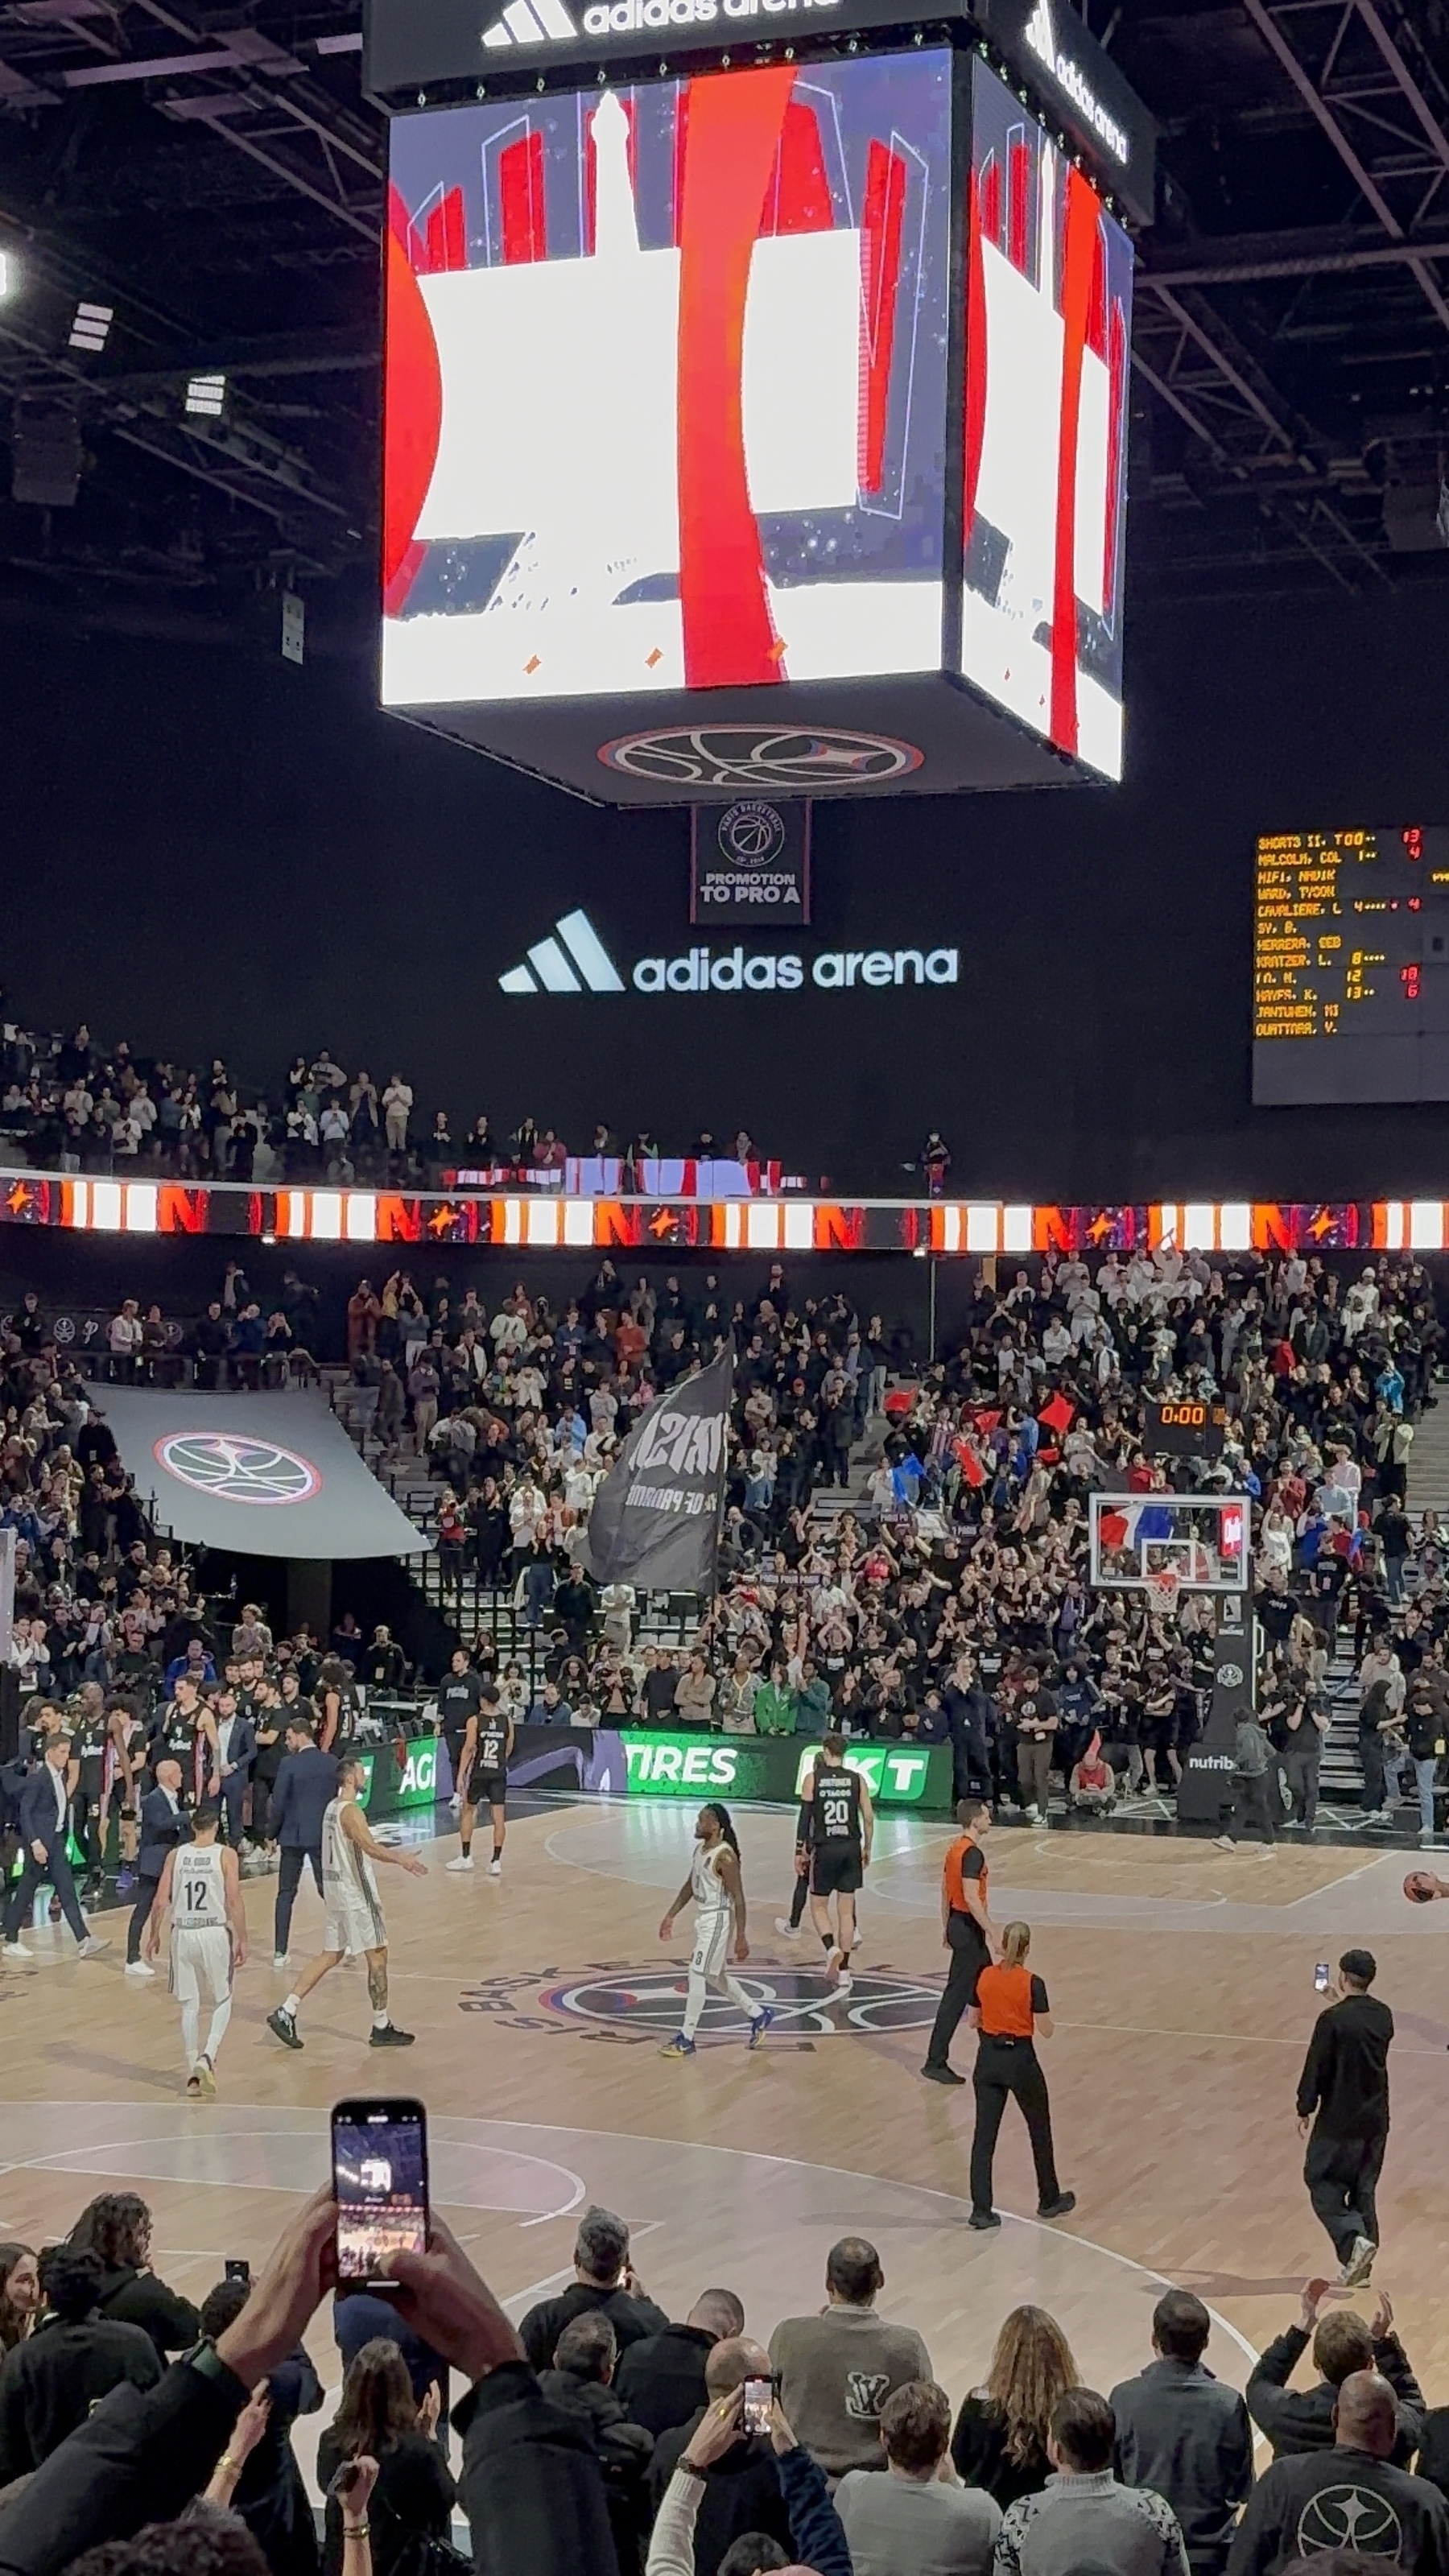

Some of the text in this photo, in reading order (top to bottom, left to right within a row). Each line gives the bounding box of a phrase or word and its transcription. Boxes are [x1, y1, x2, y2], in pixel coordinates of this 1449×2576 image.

[583, 0, 717, 34] adidas
[705, 873, 795, 886] PROMOTION
[700, 886, 801, 903] TO PRO A
[633, 947, 958, 992] adidas arena
[1347, 969, 1362, 982] 12
[484, 1739, 498, 1760] 12
[625, 1744, 738, 1784] TIRES
[1189, 1756, 1236, 1770] nutrib
[824, 1800, 848, 1825] 20
[184, 1880, 208, 1911] 12
